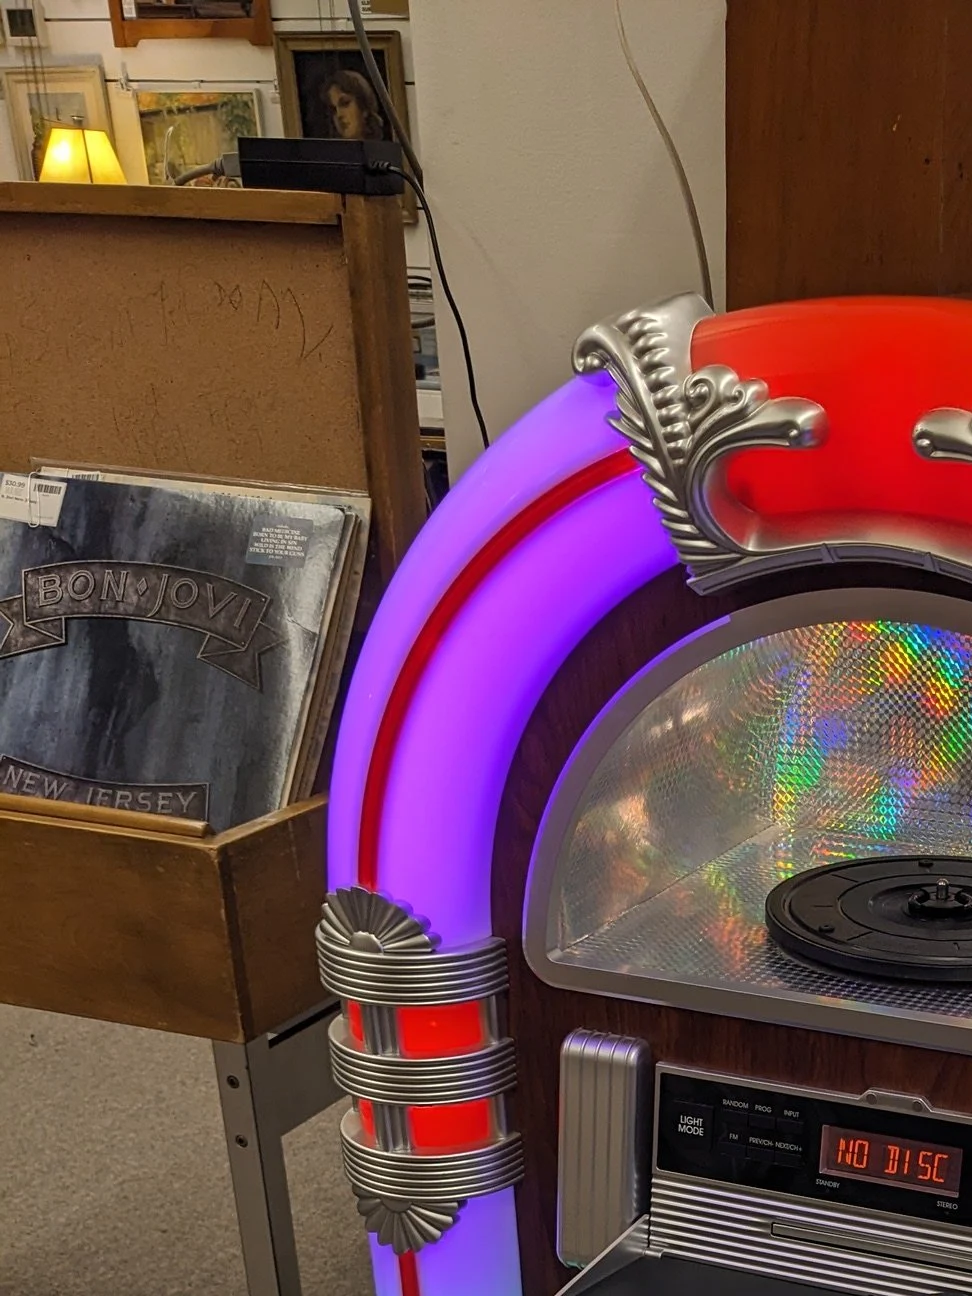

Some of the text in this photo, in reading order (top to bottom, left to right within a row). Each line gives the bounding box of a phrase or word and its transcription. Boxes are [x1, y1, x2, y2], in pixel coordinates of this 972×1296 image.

[38, 569, 251, 629] BON JOVI
[3, 764, 198, 814] NEW JERSEY
[722, 1099, 800, 1118] RANDOM PROG INPUT
[680, 1115, 704, 1127] LIGHT
[678, 1124, 704, 1136] MODE
[837, 1138, 949, 1183] NO DISC
[815, 1178, 841, 1189] STANDBY
[936, 1200, 959, 1210] STEREO
